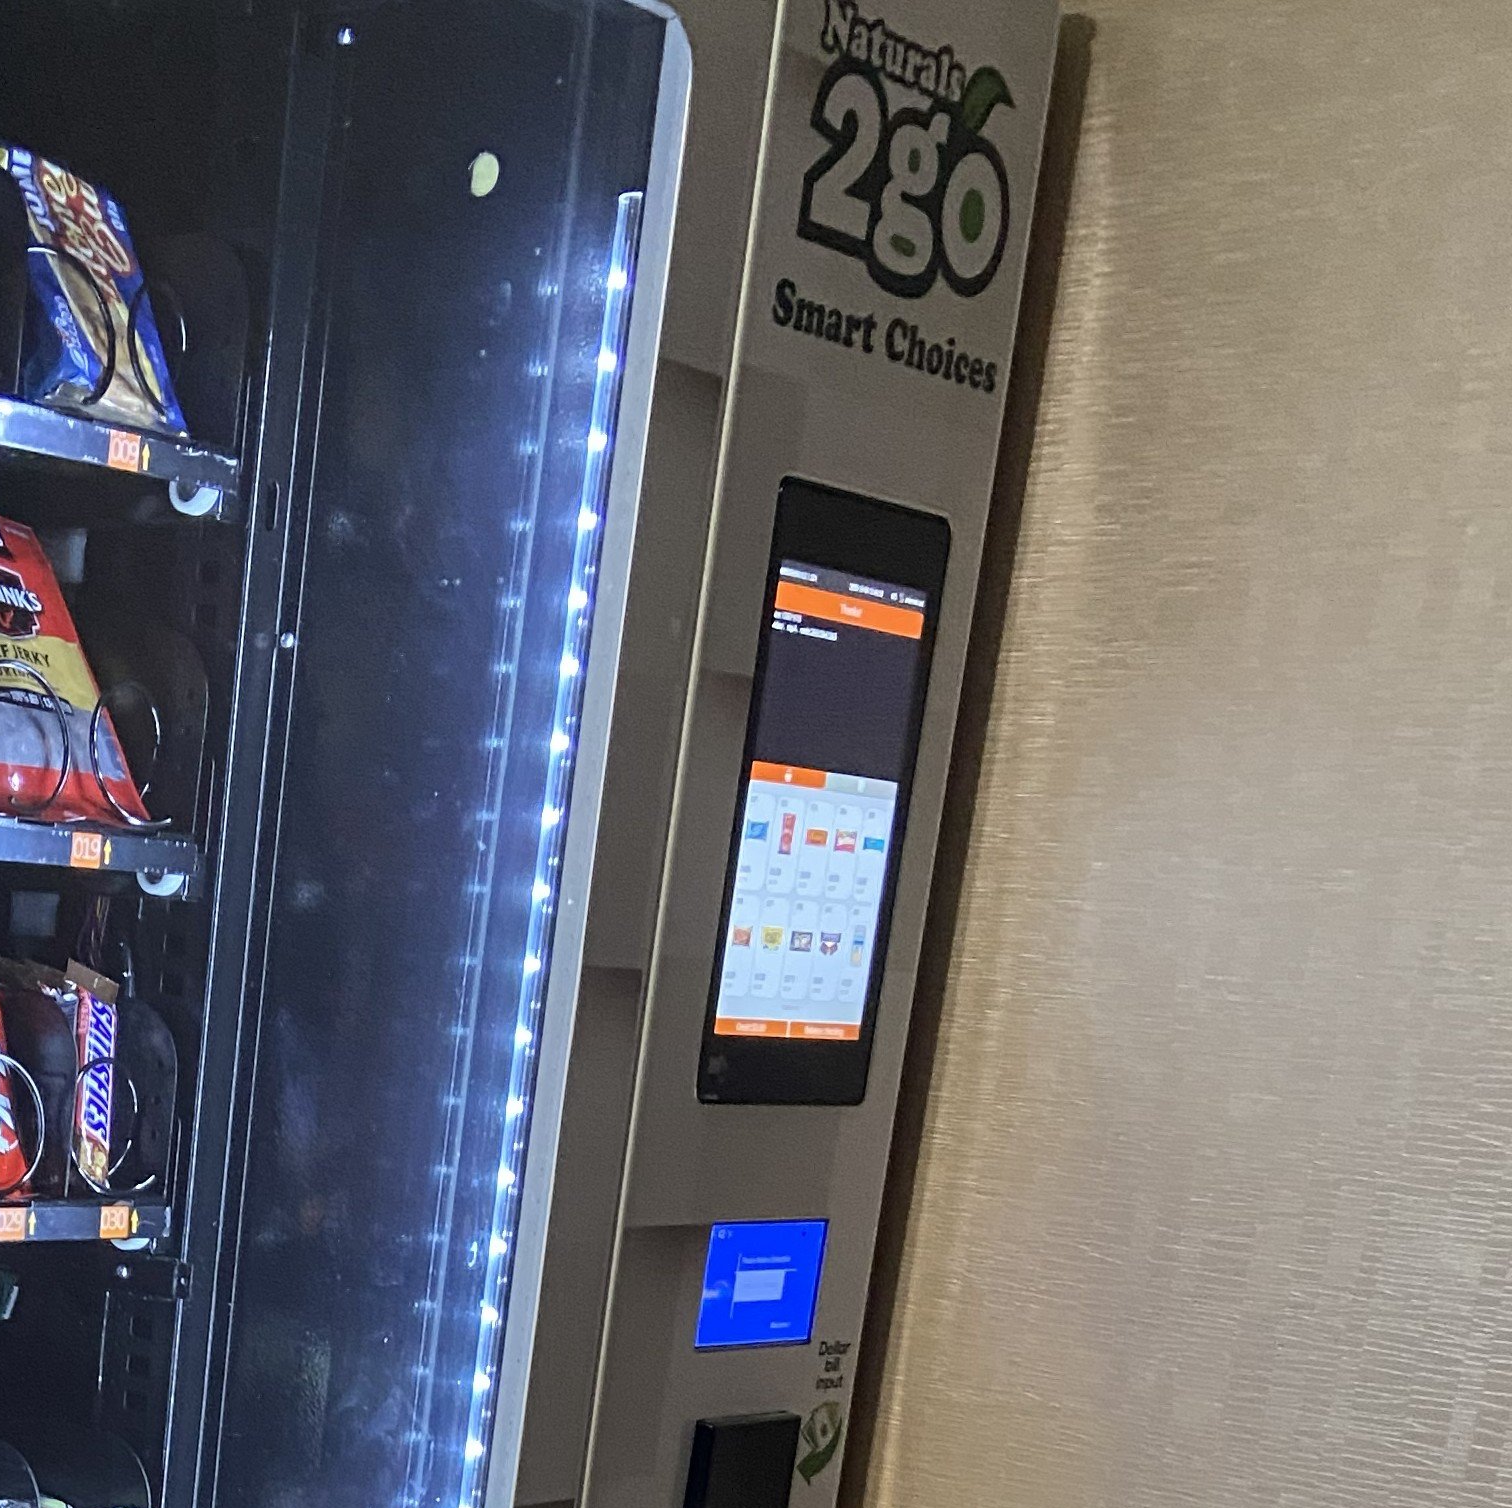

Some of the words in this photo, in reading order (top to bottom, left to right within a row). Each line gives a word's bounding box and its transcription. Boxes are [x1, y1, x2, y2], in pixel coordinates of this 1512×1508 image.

[820, 0, 967, 104] Naturals
[772, 278, 877, 354] Smart
[885, 317, 997, 394] Choices
[110, 438, 139, 466] 009
[13, 645, 50, 668] JERKY
[72, 837, 100, 859] 019
[101, 1211, 127, 1230] 030
